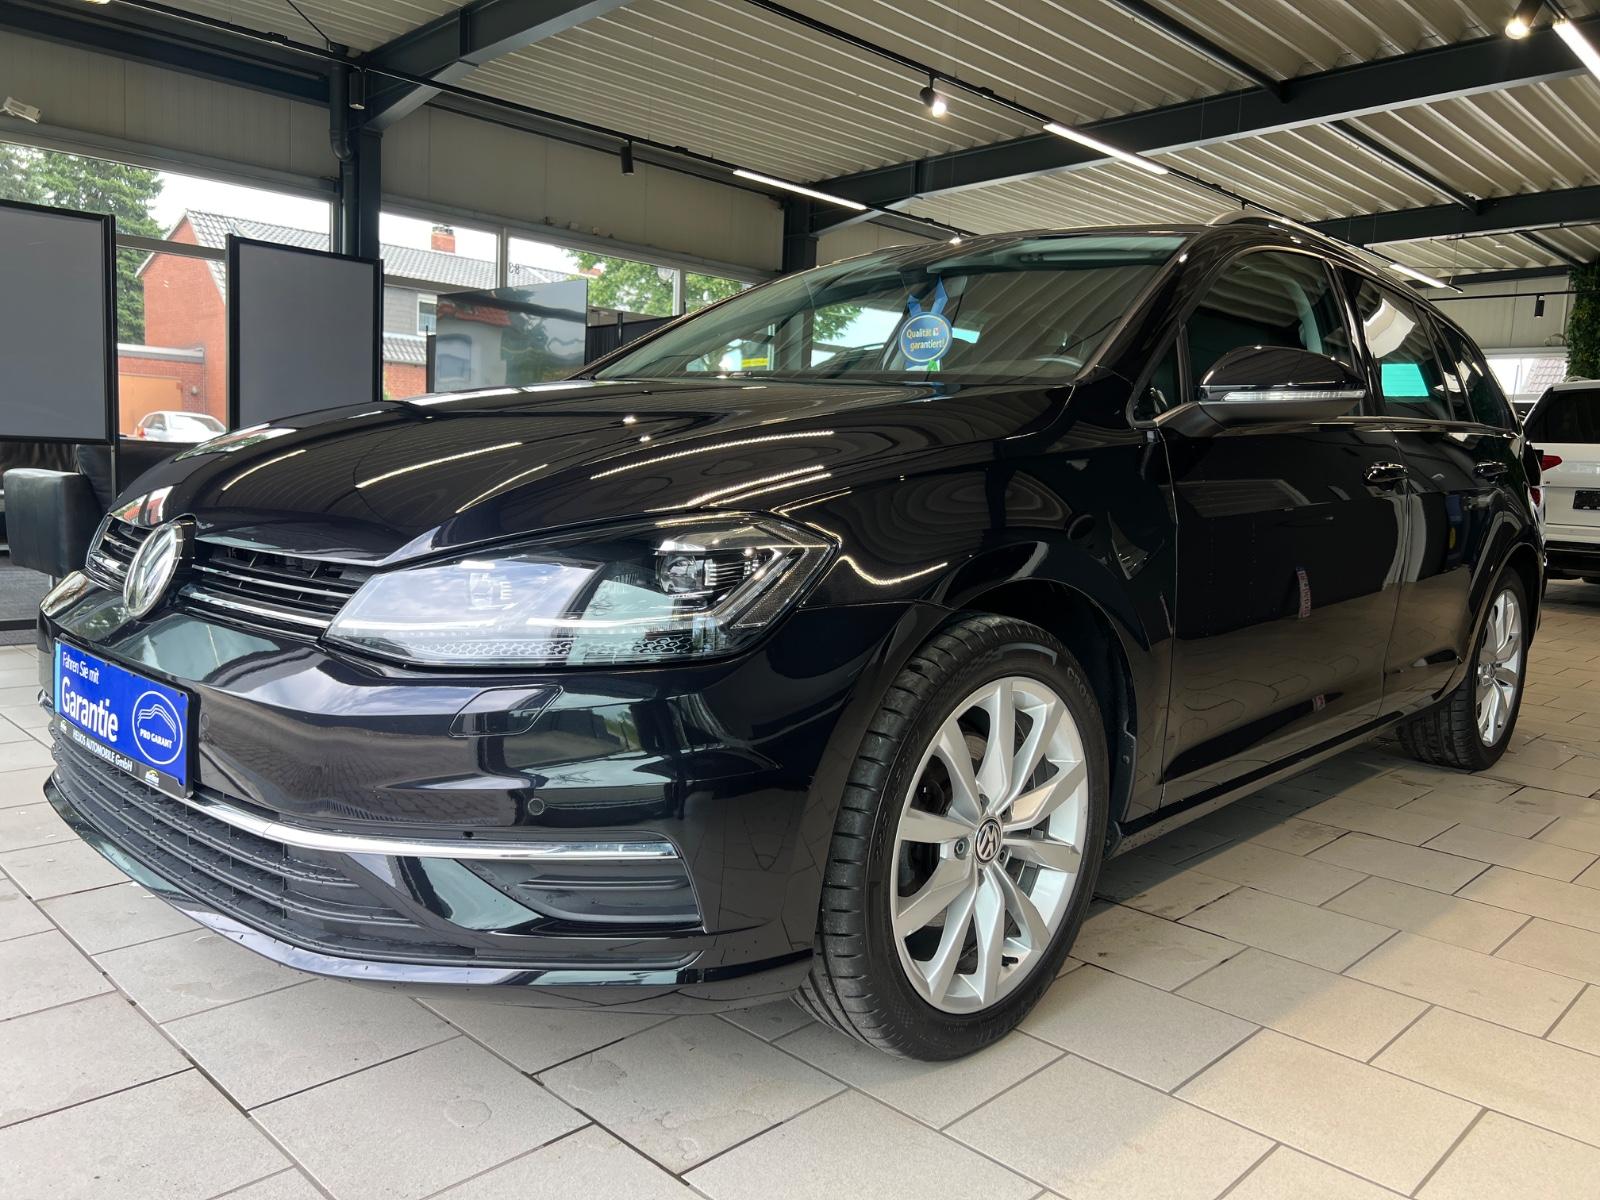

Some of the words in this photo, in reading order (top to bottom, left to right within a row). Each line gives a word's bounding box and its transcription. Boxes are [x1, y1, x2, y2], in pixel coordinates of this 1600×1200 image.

[62, 652, 79, 673] Fahren
[79, 661, 89, 678] Sie
[89, 668, 100, 685] mit
[61, 676, 119, 743] Garantie
[86, 738, 115, 762] AUTOMOBILE
[115, 754, 133, 772] GmbH
[139, 728, 150, 742] PRO
[151, 736, 173, 749] GARANT
